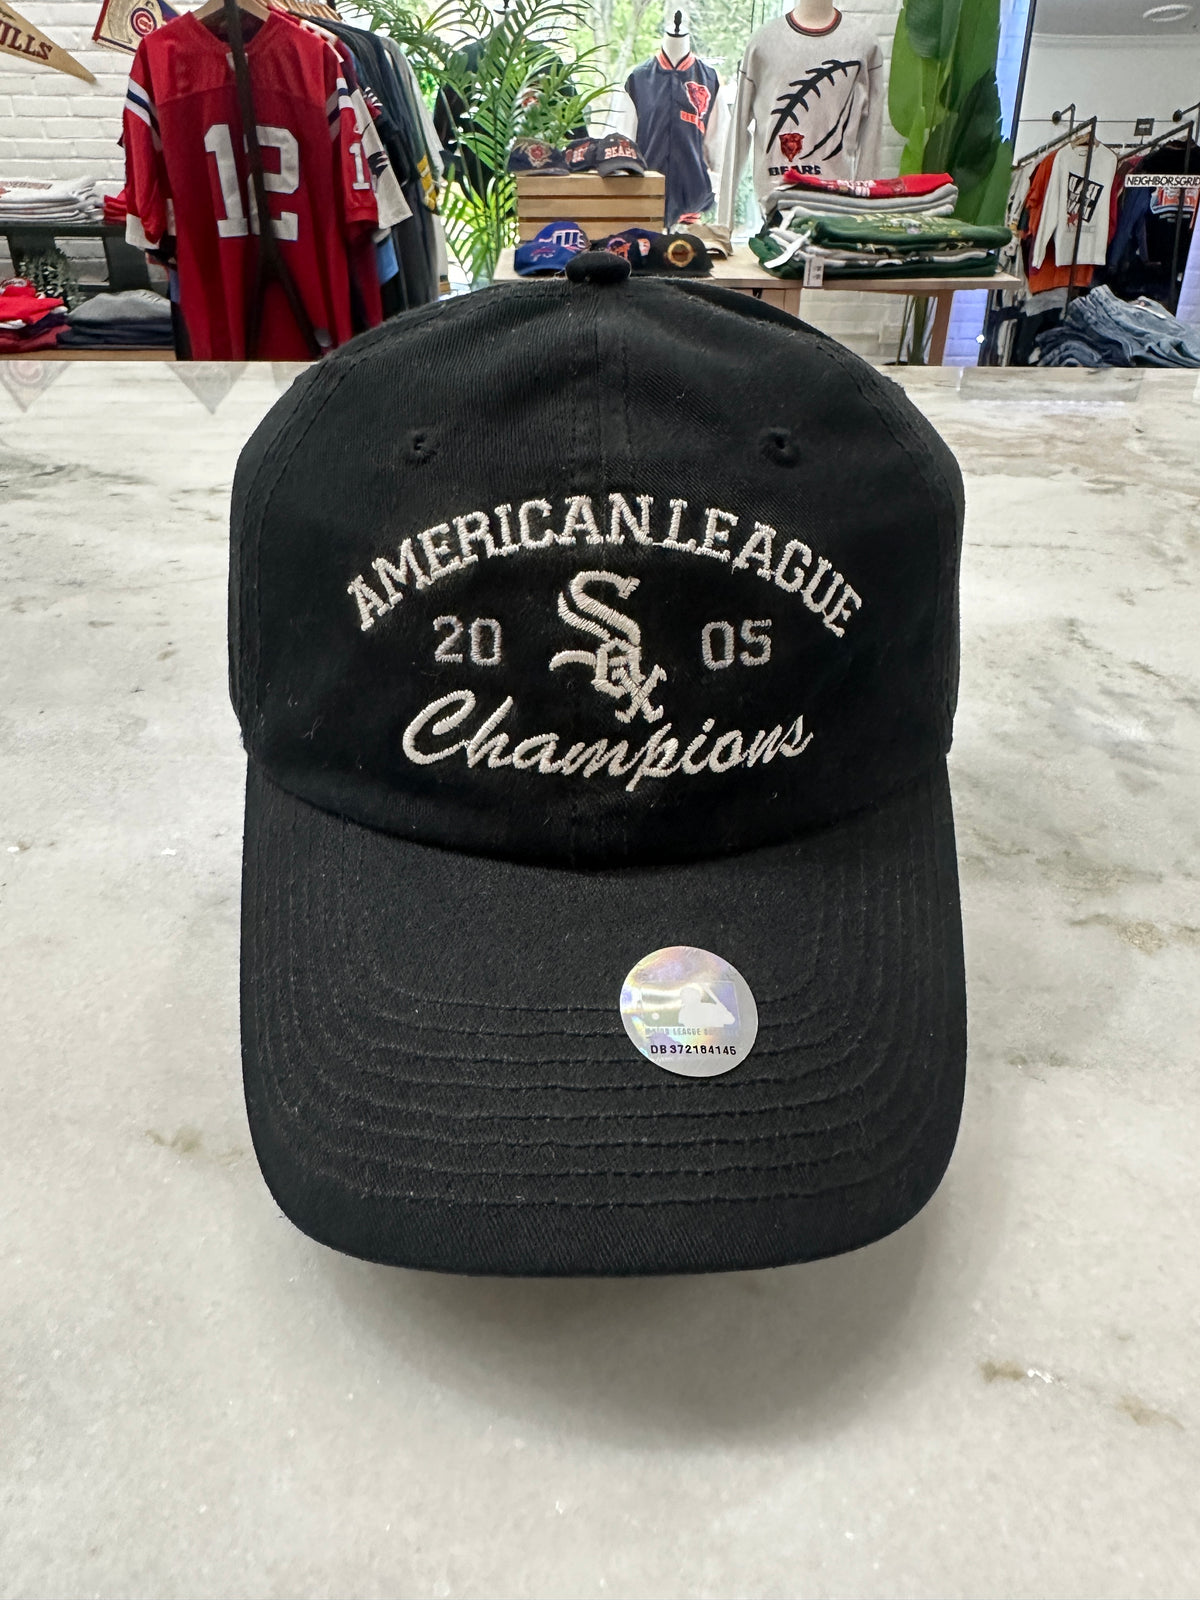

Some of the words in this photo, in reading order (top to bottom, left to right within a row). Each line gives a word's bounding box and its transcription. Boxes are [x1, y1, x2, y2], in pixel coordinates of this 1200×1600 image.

[204, 124, 299, 241] 12
[347, 493, 653, 631] AMERICAN
[661, 498, 862, 638] LEAGUE
[433, 615, 502, 666] 20
[701, 619, 772, 670] 05
[402, 689, 814, 792] Champions
